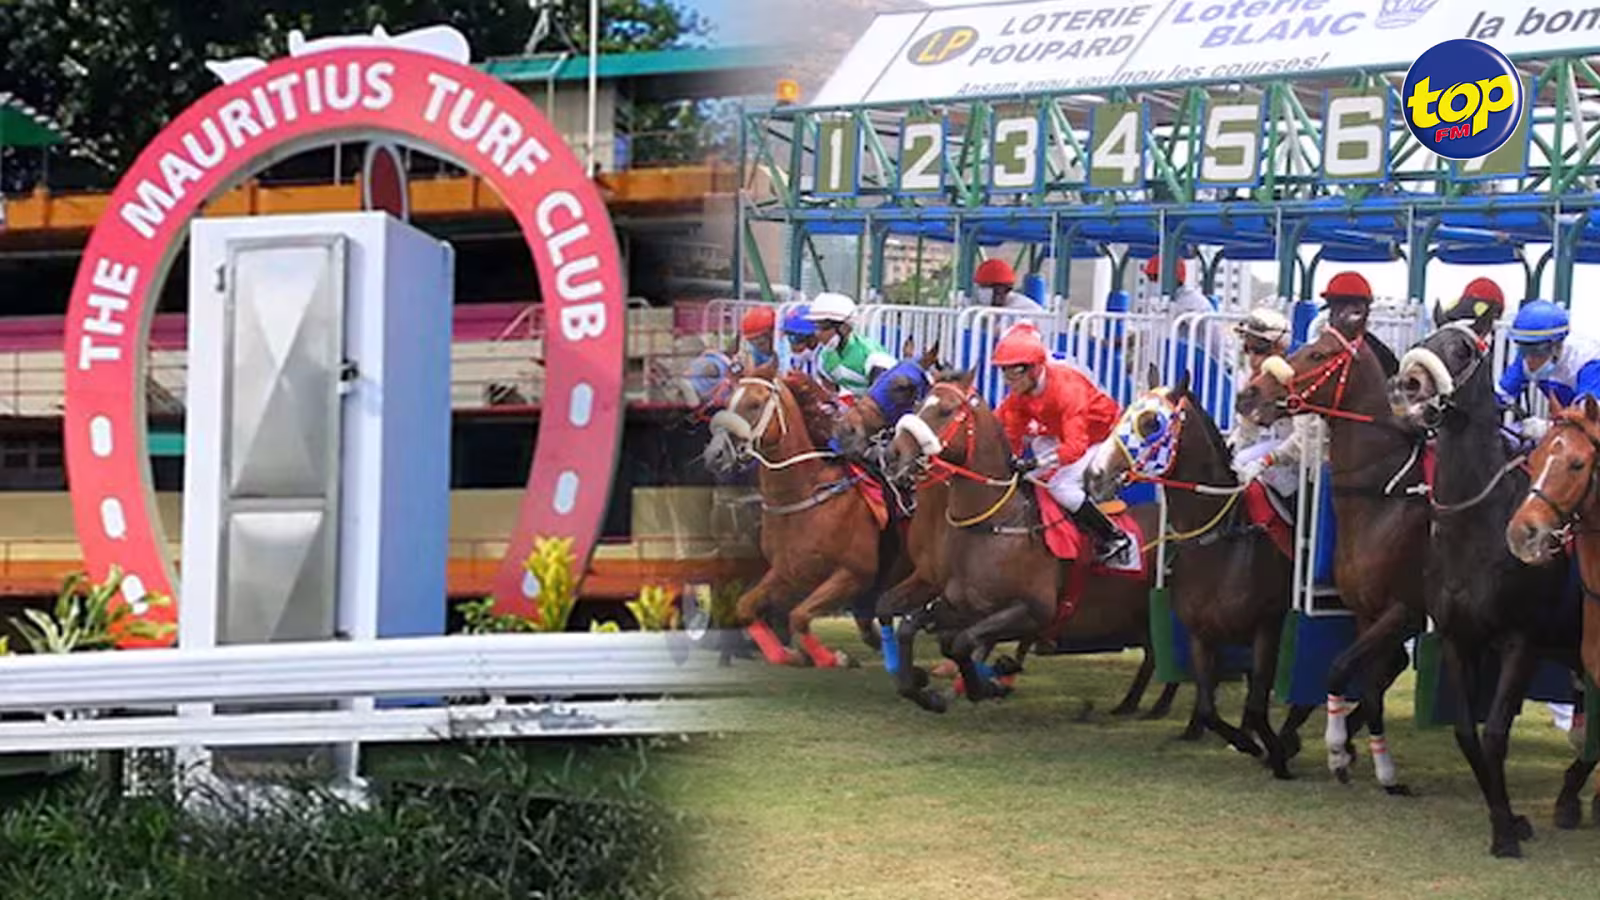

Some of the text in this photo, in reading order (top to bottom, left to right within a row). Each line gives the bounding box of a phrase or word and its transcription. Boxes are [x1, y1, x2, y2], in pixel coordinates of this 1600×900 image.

[1000, 5, 1151, 36] LOTERIE
[1173, 0, 1330, 24] Loterie
[1200, 12, 1366, 48] BLANC
[1465, 6, 1600, 39] la bon
[917, 29, 974, 63] LP
[969, 34, 1135, 66] POUPARD
[1211, 52, 1330, 77] courses!
[830, 128, 843, 190] 1
[902, 123, 943, 188] 2
[994, 117, 1039, 186] 3
[1092, 111, 1140, 183] 4
[1201, 104, 1259, 181] 5
[1324, 97, 1384, 175] 6
[79, 61, 607, 369] THE MAURITIUS TURF CLUB
